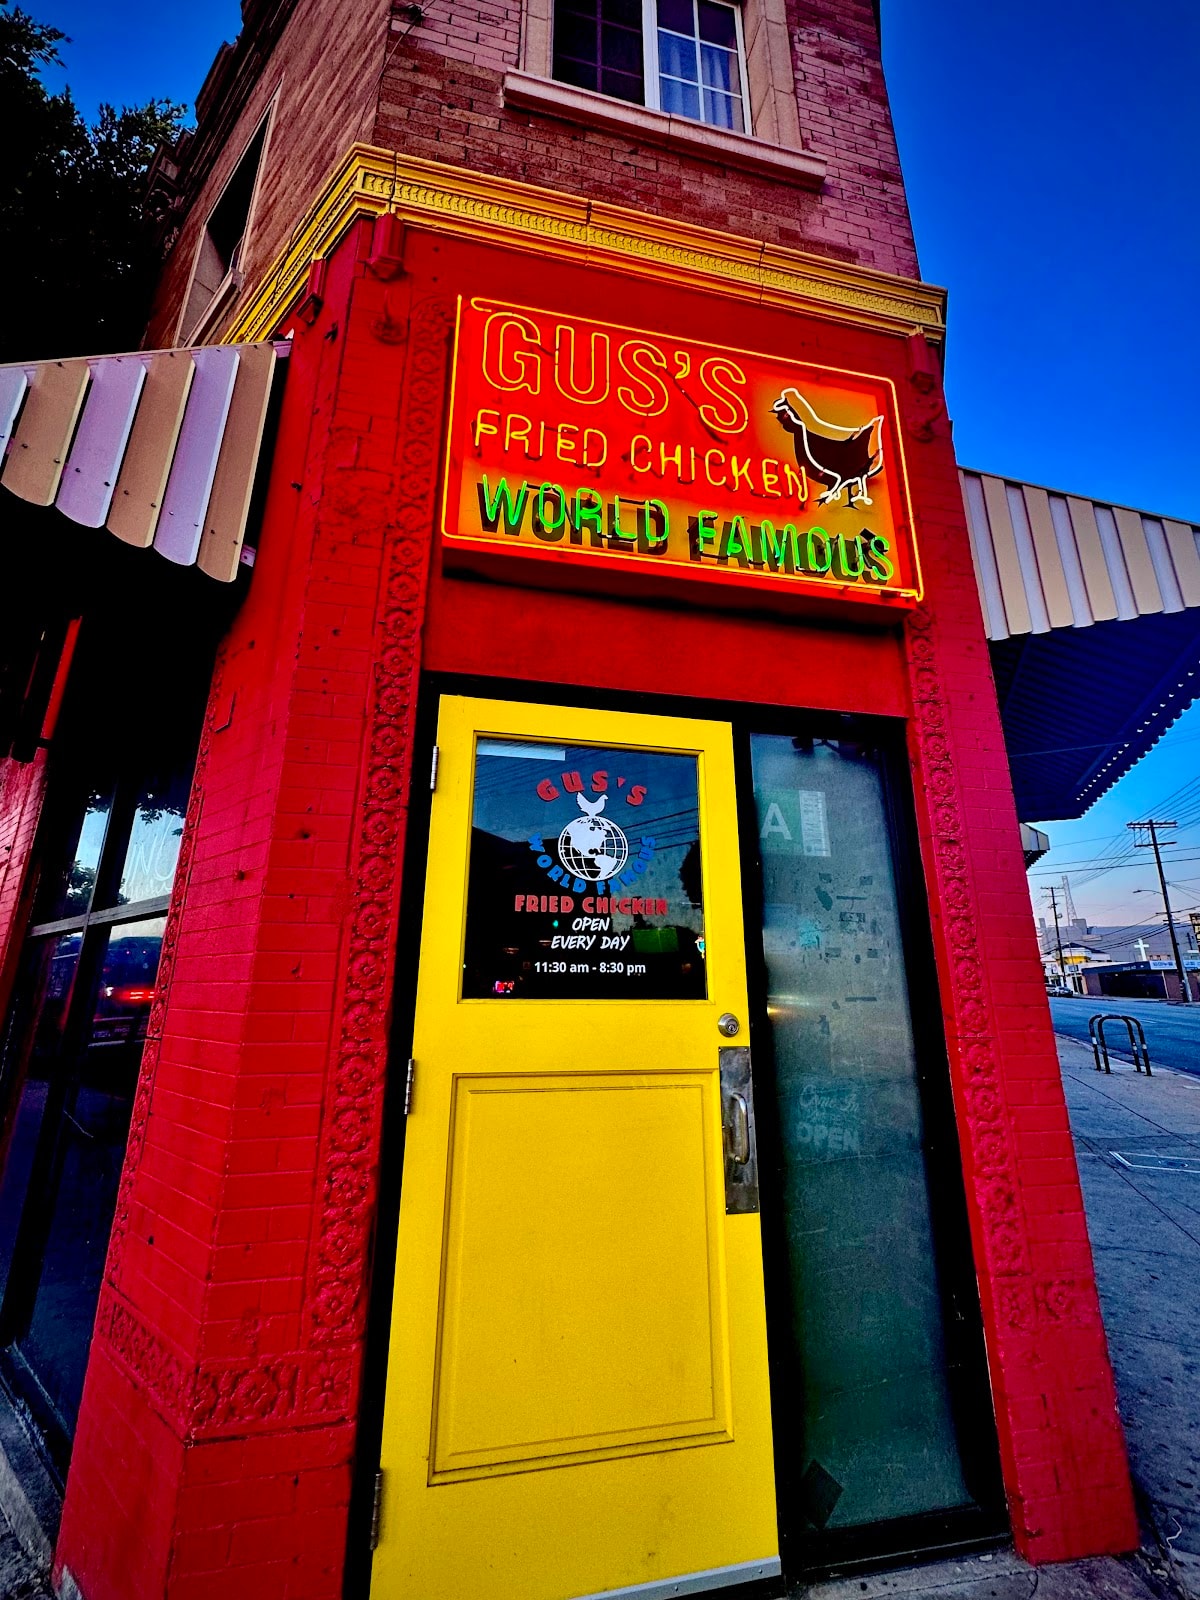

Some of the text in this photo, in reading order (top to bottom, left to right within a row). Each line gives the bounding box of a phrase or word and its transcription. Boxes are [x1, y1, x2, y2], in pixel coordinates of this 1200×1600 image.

[482, 312, 748, 433] GUS'S
[473, 408, 810, 504] FRIED CHICKEN
[477, 474, 896, 586] WORLD FAMOUS
[536, 770, 648, 806] GUS'S
[759, 802, 793, 840] A
[527, 831, 656, 895] WORLD FAMOUS
[514, 894, 669, 916] FRIED CHICKEN
[571, 916, 610, 932] OPEN
[550, 934, 630, 951] EVERY DAY
[534, 961, 567, 973] 11:30
[569, 964, 590, 974] am
[599, 961, 624, 974] 8:30
[626, 964, 647, 976] pm
[796, 1121, 860, 1151] OPEN
